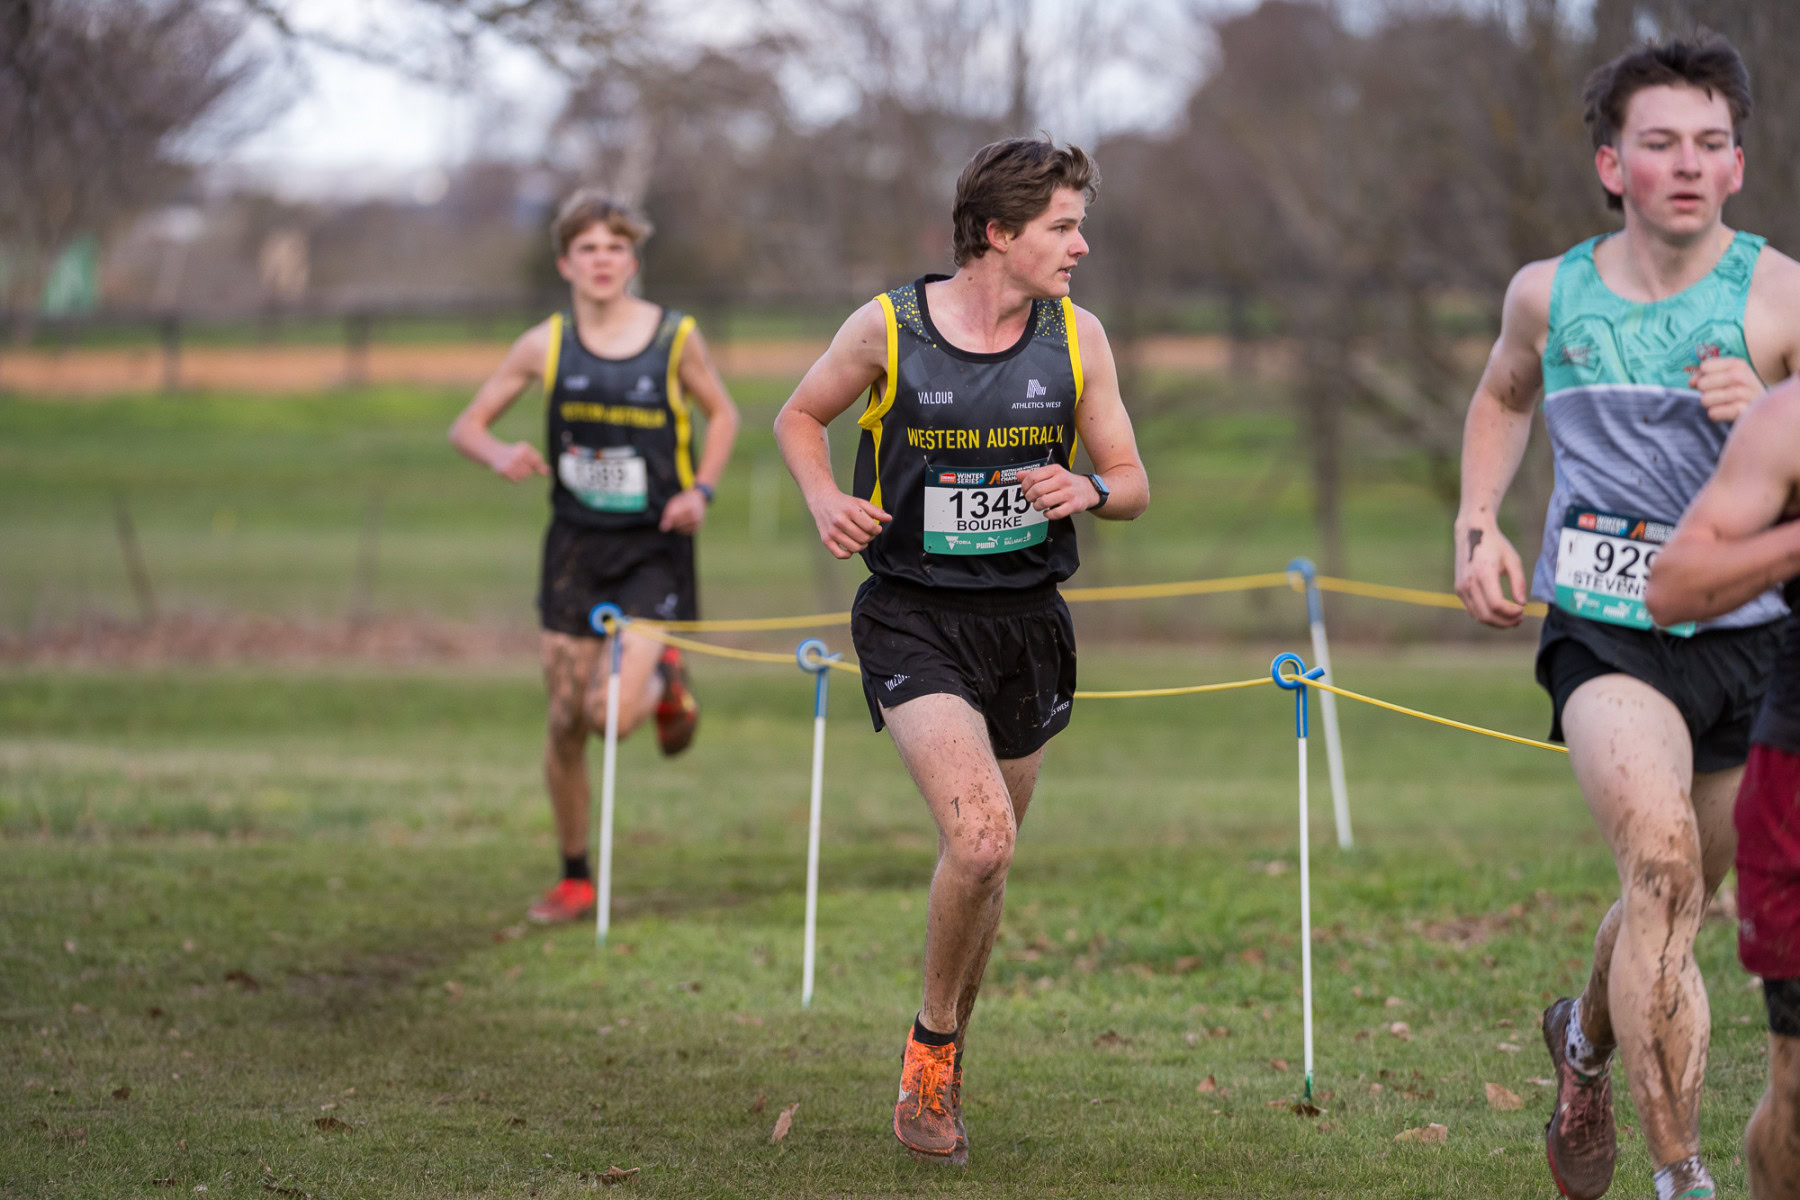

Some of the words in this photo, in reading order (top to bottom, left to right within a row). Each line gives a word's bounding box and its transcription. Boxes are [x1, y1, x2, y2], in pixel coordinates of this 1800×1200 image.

[917, 391, 954, 405] VALOUR
[1011, 402, 1045, 410] ATHLETICS
[1045, 401, 1062, 409] WEST
[907, 426, 980, 450] WESTERN
[957, 472, 985, 480] WINTER
[949, 488, 1031, 519] 1345
[957, 515, 1022, 531] BOURKE
[976, 541, 996, 549] PUMA
[1573, 571, 1649, 596] STEVEN
